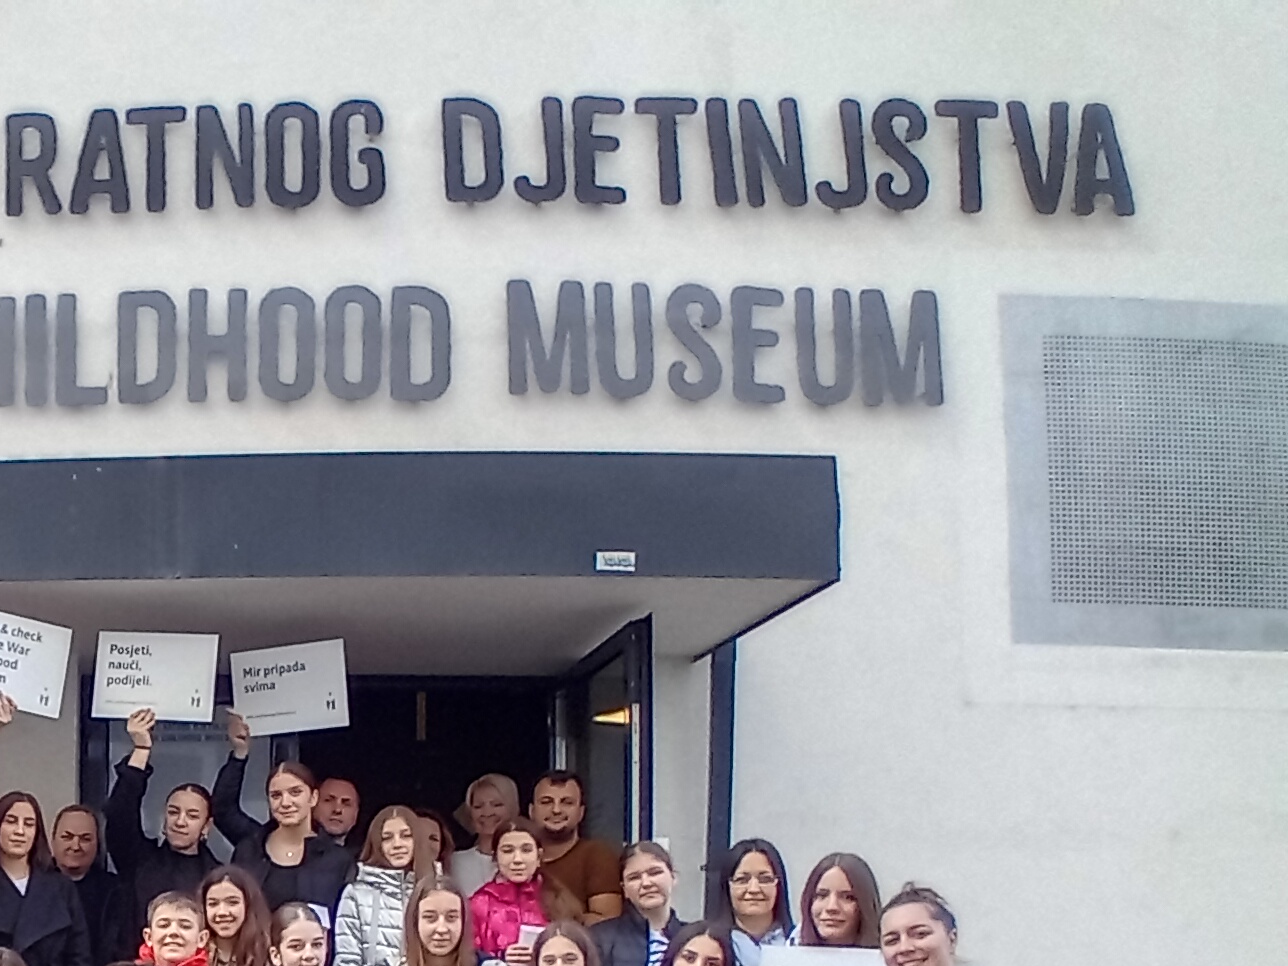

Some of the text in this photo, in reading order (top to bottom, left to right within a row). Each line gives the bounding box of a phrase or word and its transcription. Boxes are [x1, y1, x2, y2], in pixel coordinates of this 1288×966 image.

[5, 100, 387, 216] RATNOG
[441, 95, 1135, 216] DJETINJSTVA
[506, 279, 944, 406] MUSEUM
[0, 624, 9, 635] &
[11, 626, 43, 643] check
[7, 640, 31, 656] War
[109, 643, 152, 658] Posjeti,
[108, 659, 142, 672] nauči,
[243, 662, 306, 678] Mir pripada
[106, 674, 153, 688] podijeli.
[244, 681, 276, 693] svima
